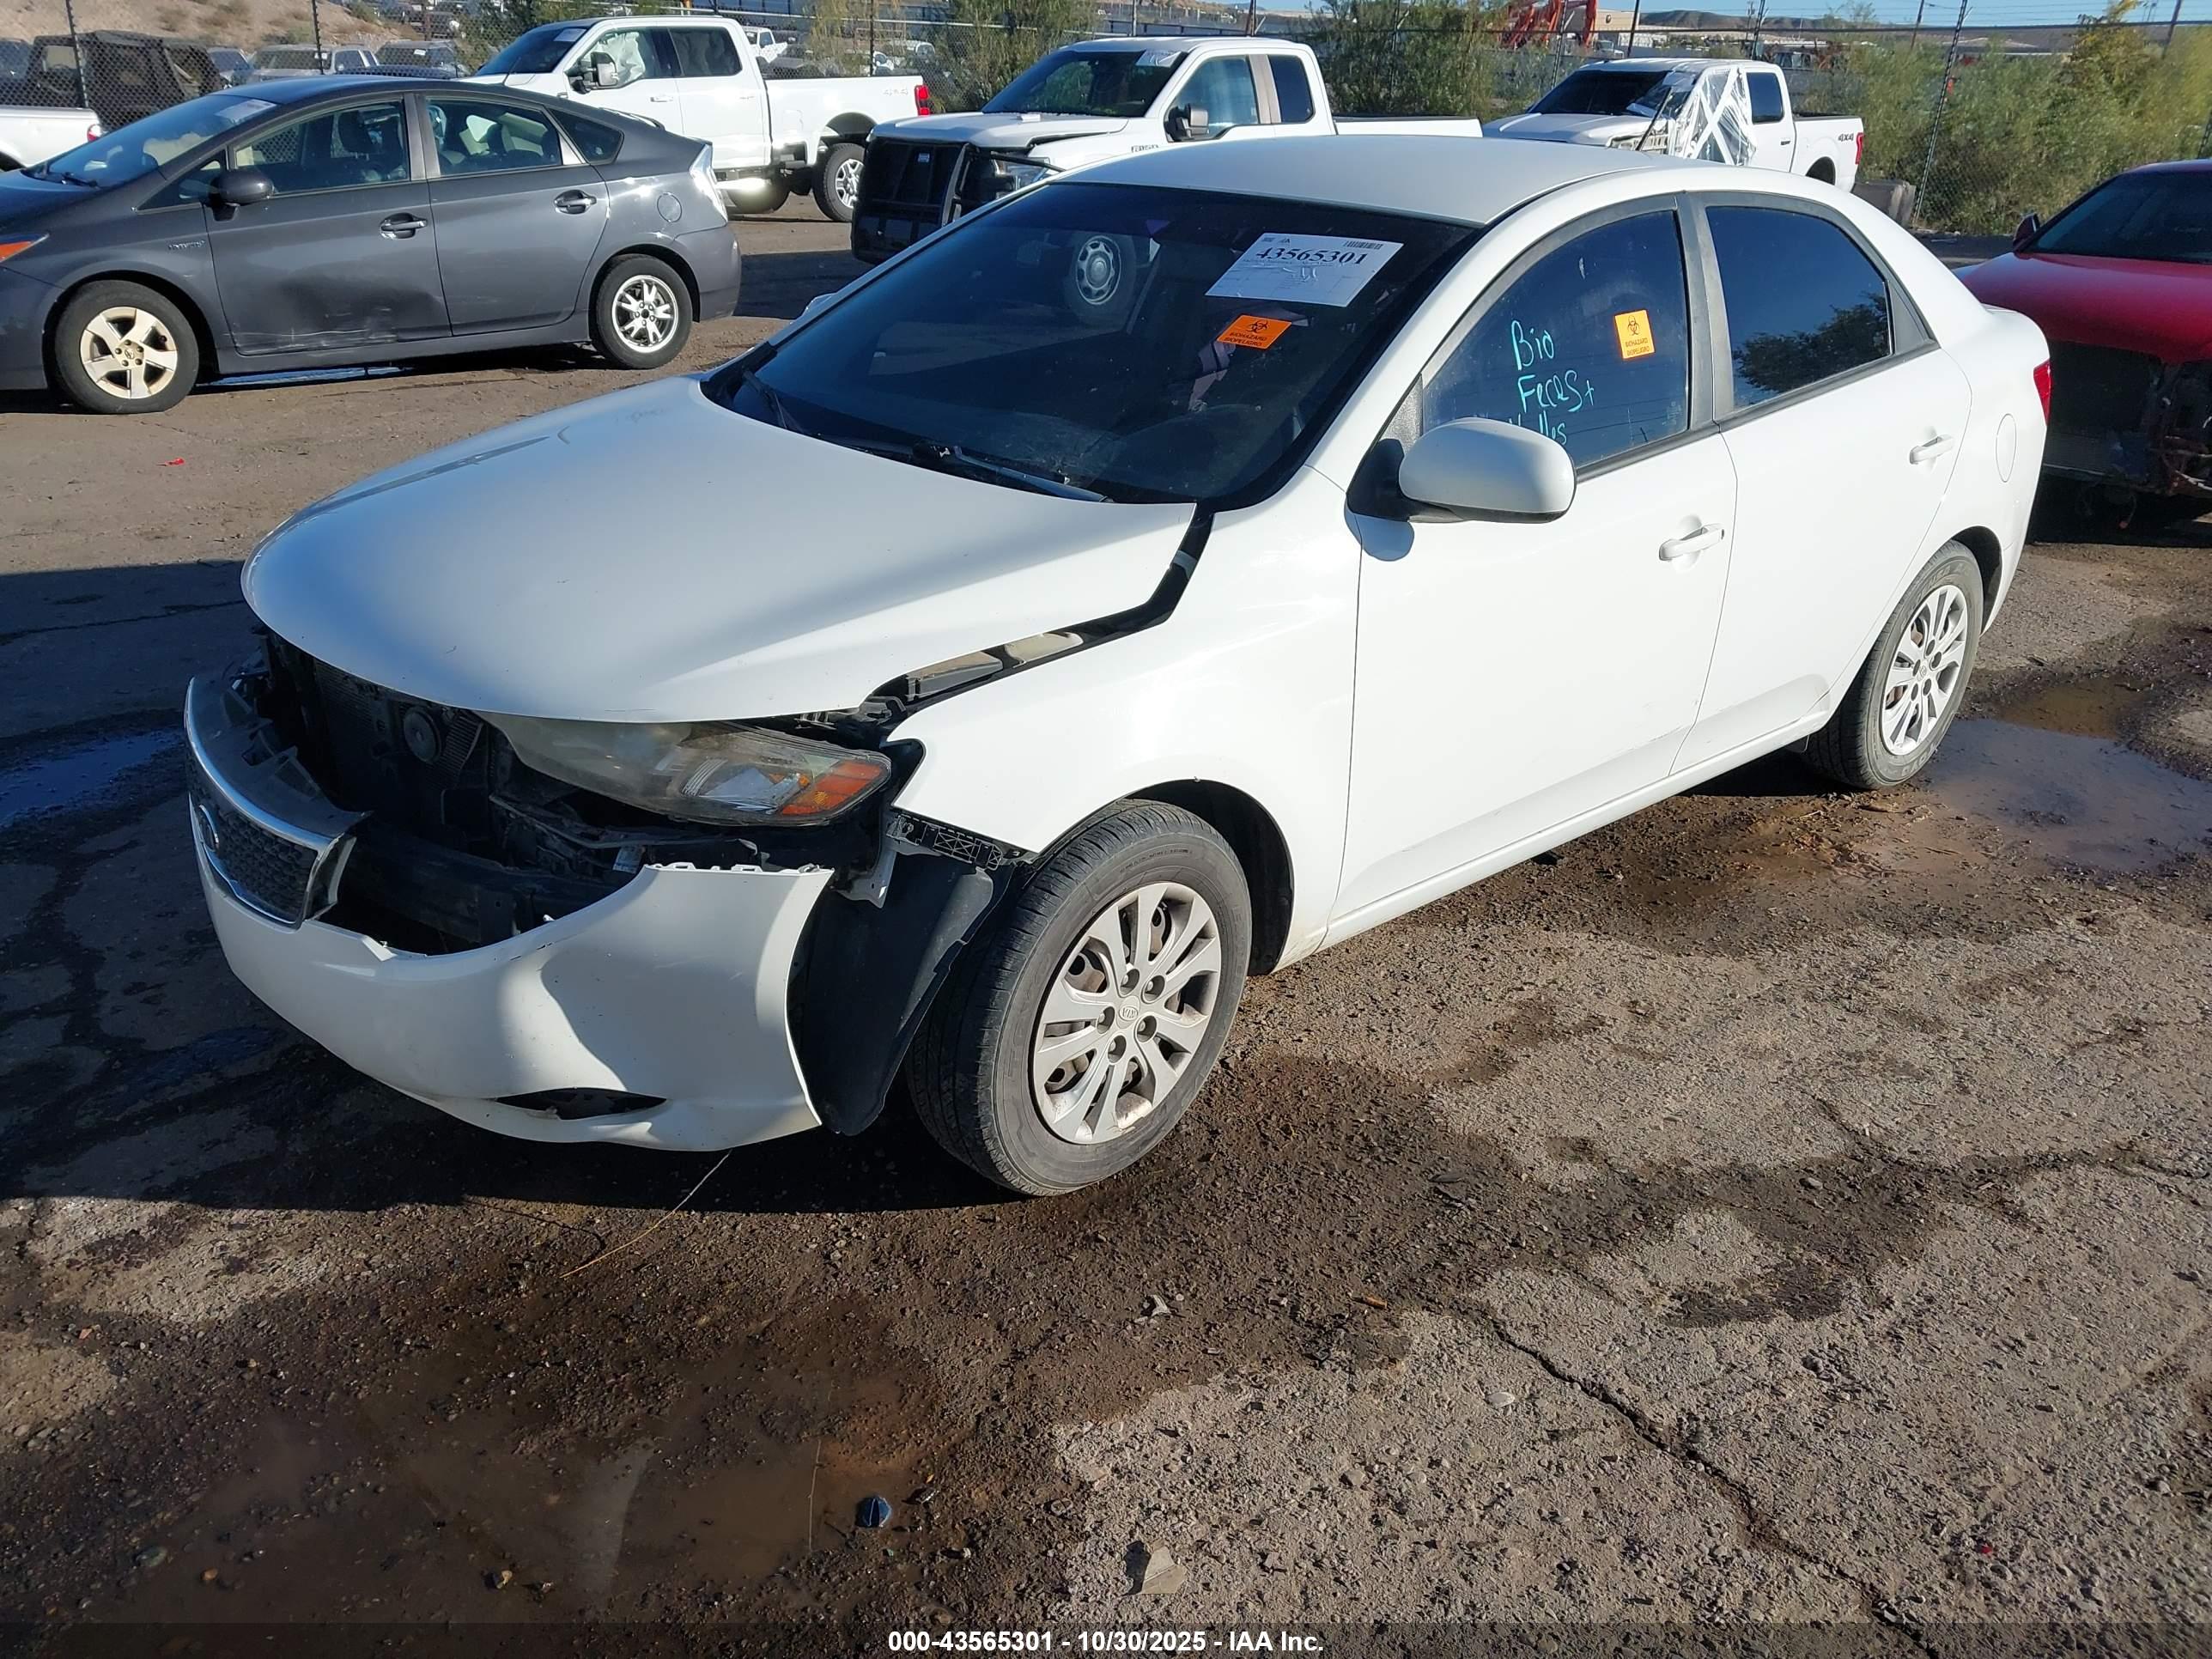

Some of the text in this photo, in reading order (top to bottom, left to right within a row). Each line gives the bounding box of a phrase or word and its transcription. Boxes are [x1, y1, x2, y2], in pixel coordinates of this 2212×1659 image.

[1256, 247, 1368, 264] 43565301
[1229, 332, 1267, 341] BIOHAZARD
[1511, 320, 1554, 370] Bio
